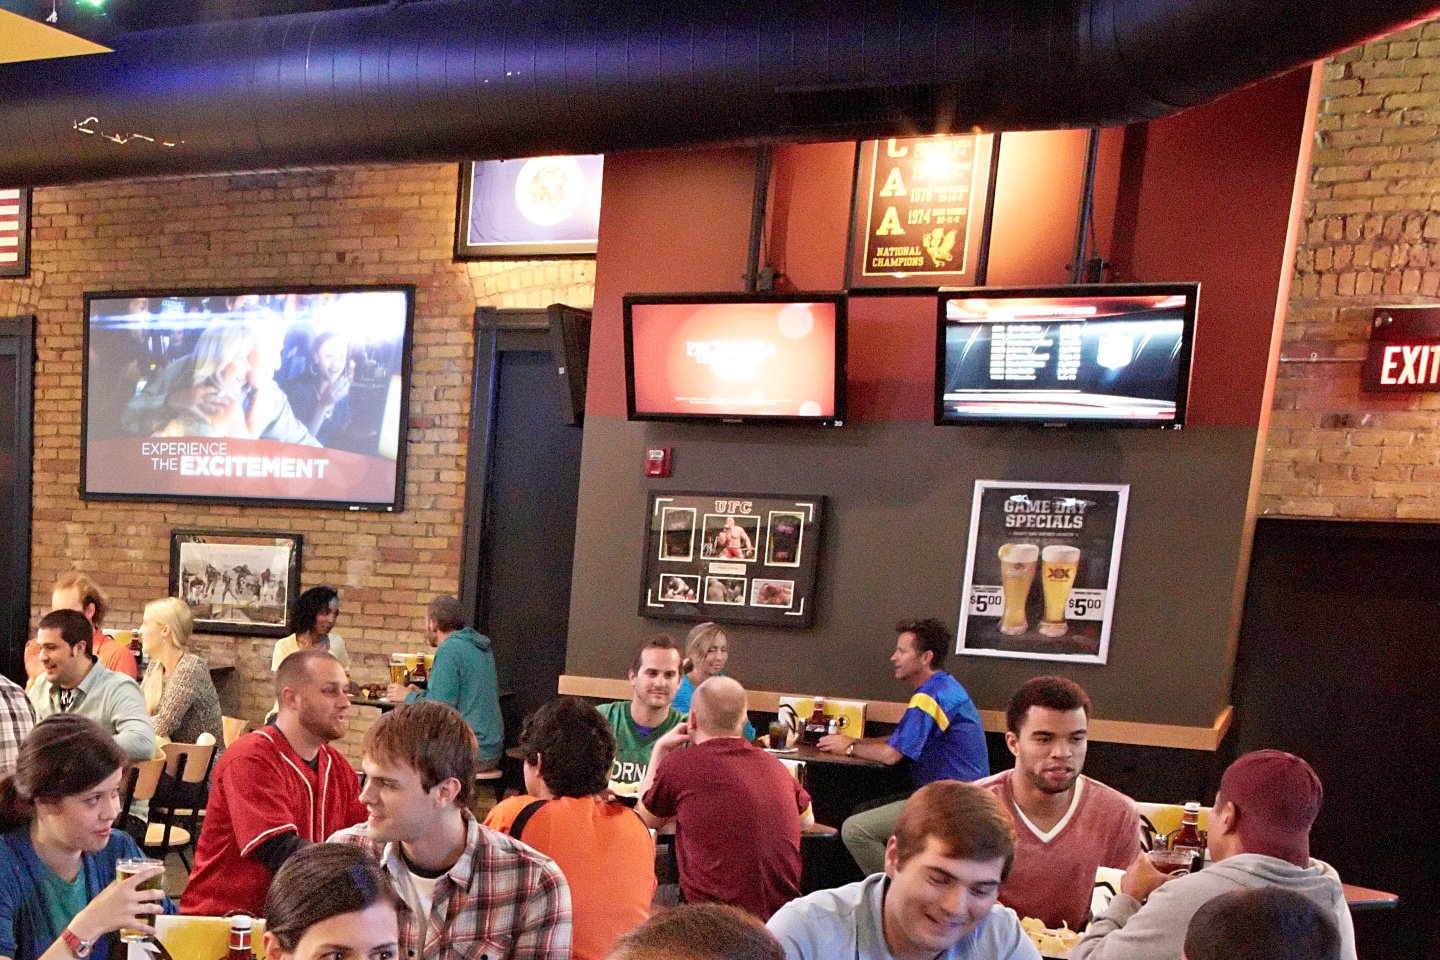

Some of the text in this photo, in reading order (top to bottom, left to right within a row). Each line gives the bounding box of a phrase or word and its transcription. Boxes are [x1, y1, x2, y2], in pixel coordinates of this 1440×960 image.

[907, 209, 931, 225] 1974
[877, 246, 921, 257] NATIONAL
[872, 257, 923, 267] CHAMPIONS
[1380, 345, 1440, 385] EXIT
[142, 442, 228, 456] EXPERIENCE
[151, 455, 329, 479] THE EXCITEMENT
[715, 500, 752, 514] UFC
[1004, 499, 1088, 514] GAME DAY
[1005, 514, 1083, 529] SPECIALS
